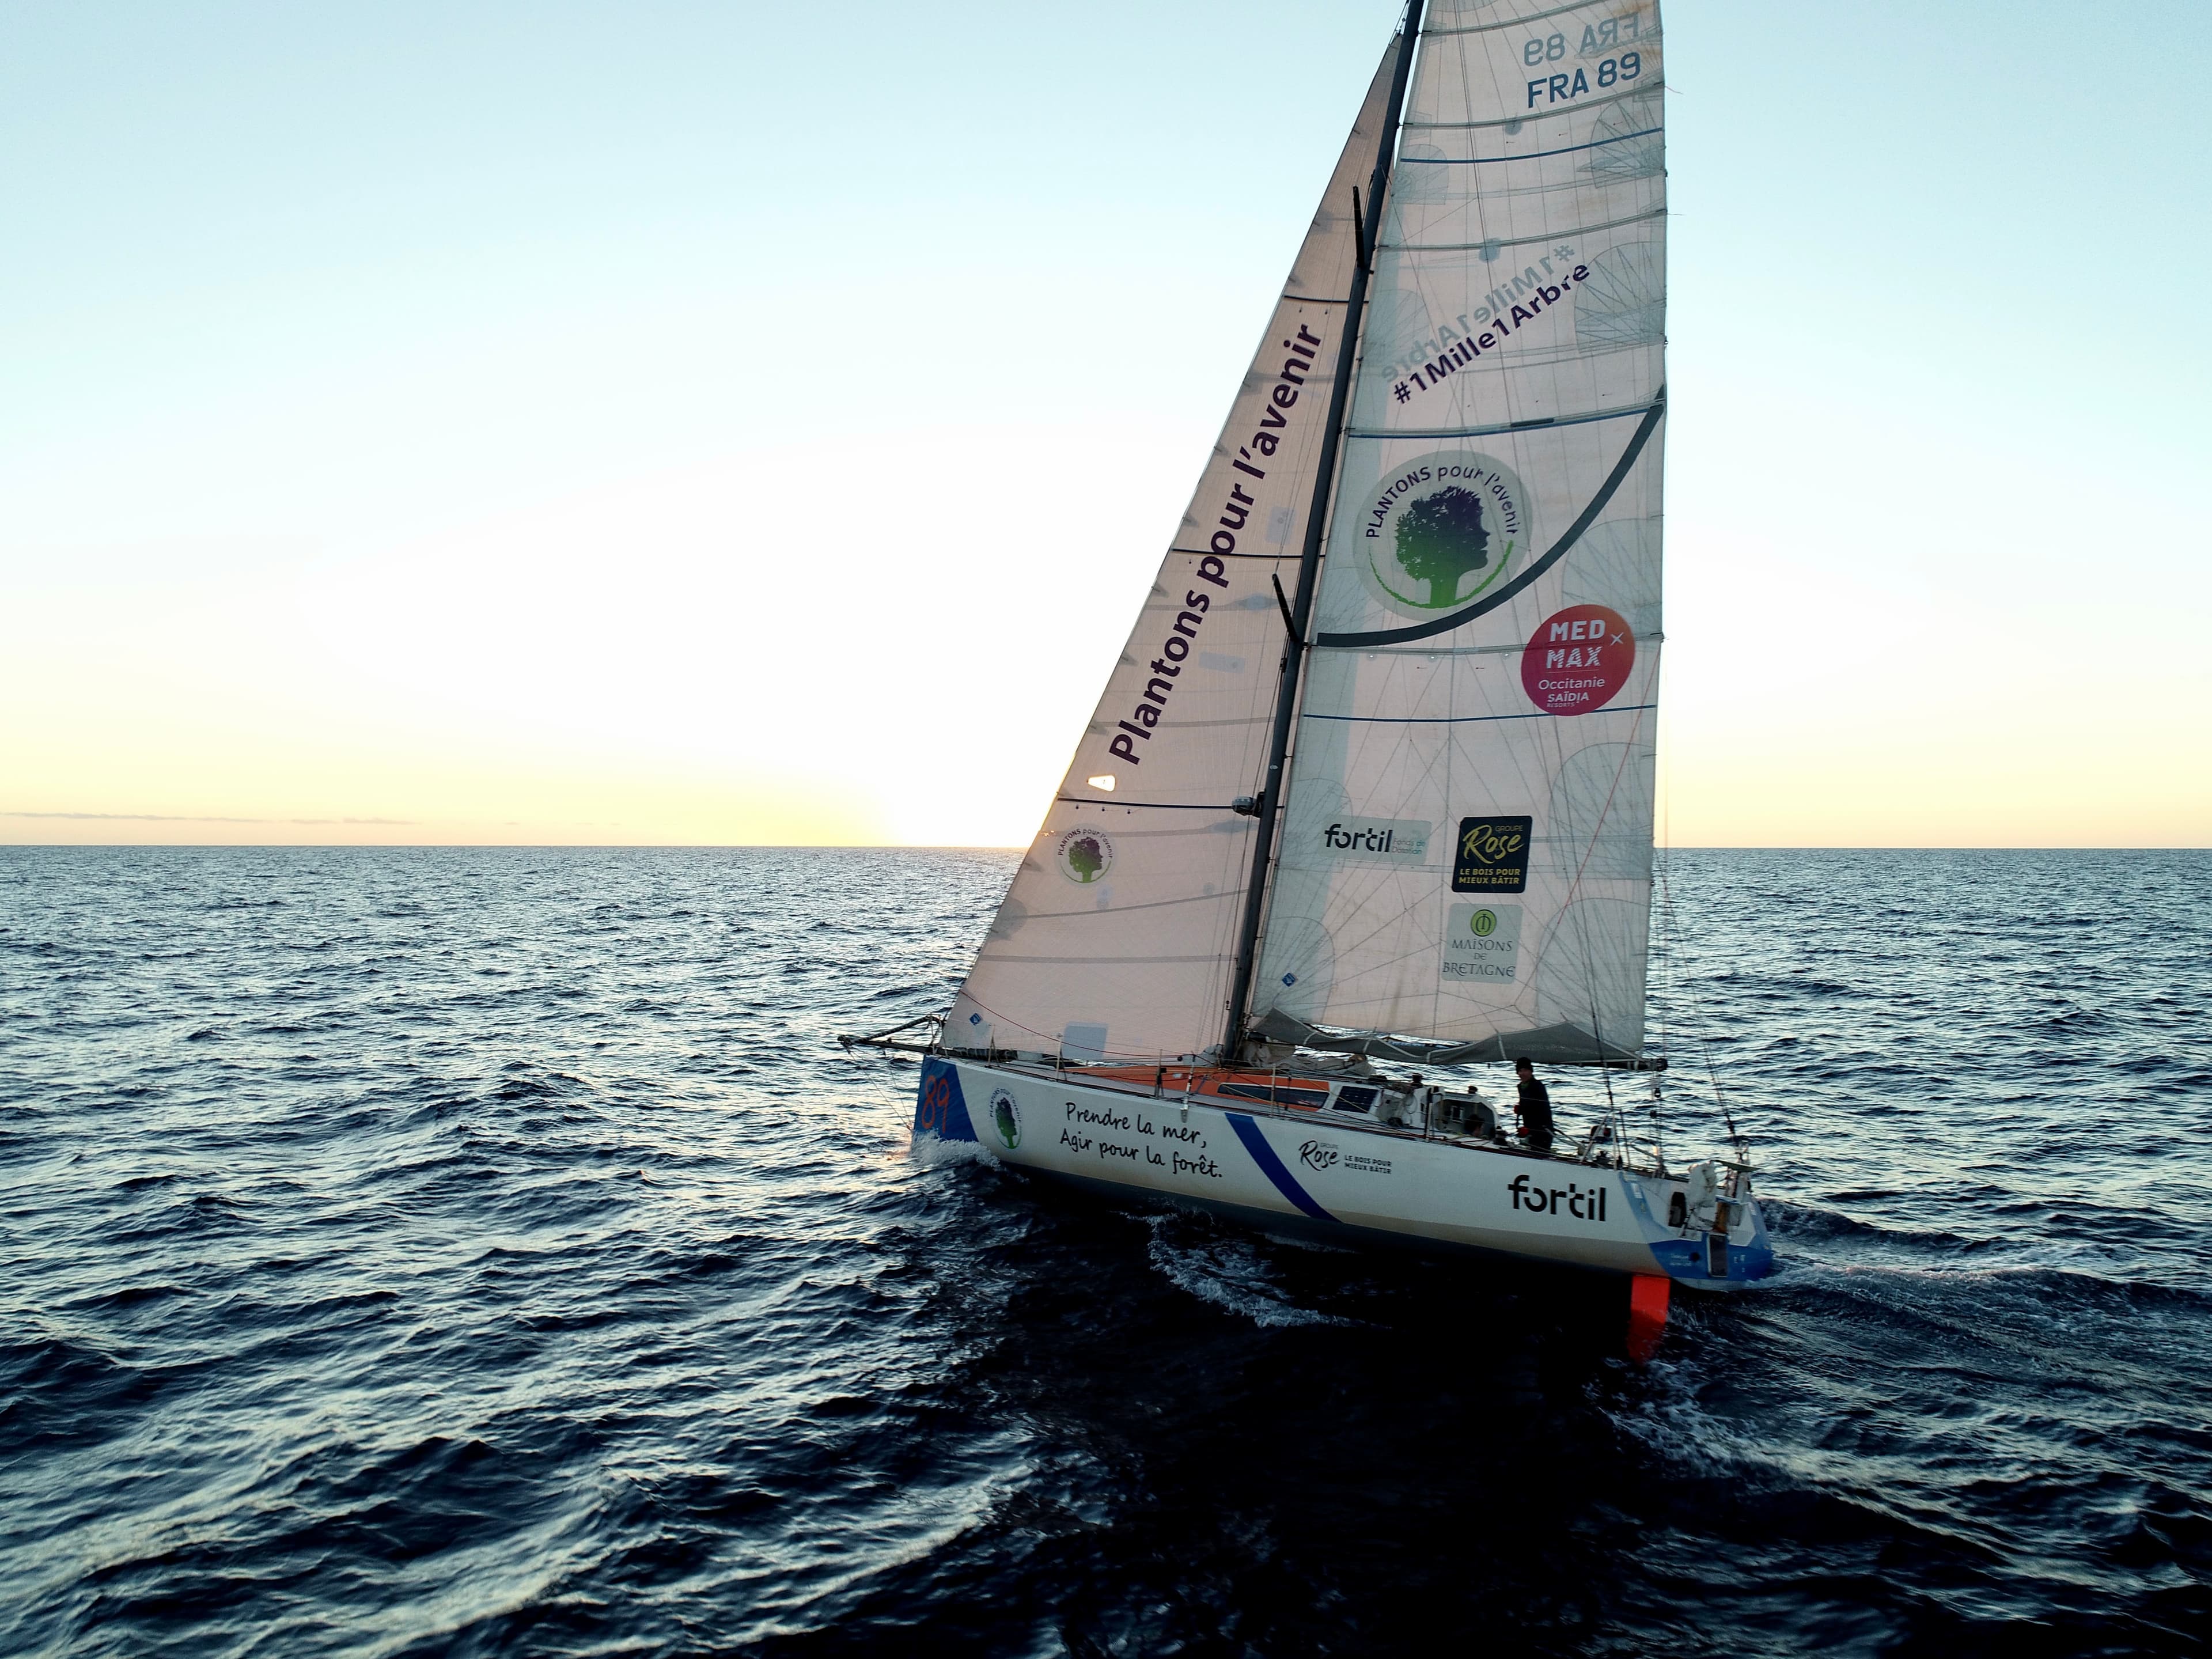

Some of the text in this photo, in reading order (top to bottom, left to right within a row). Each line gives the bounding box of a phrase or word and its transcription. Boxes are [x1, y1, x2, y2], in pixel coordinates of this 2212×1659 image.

[1527, 52, 1641, 108] FRA 89
[1393, 264, 1590, 404] #1Mille1Arbre
[1366, 465, 1521, 537] PLANTONS pour l'avenir
[1108, 323, 1321, 766] Plantons pour l'avenir
[1550, 619, 1606, 642] MED
[1546, 646, 1603, 669] MAX
[1539, 676, 1605, 690] Occitanie
[1058, 828, 1081, 856] PLANTONS
[1324, 823, 1393, 853] fortil
[1463, 824, 1525, 864] Rose
[1491, 876, 1520, 884] BÂTIR
[1442, 962, 1516, 977] BRETAGNE
[922, 1075, 950, 1134] 89
[1066, 1102, 1206, 1148] Prendre la mer,
[1060, 1128, 1222, 1177] Agir pour la forêt.
[1298, 1140, 1340, 1172] Rose
[1344, 1162, 1392, 1175] MIEUX BÂTIR
[1354, 1156, 1370, 1164] BOIS
[1372, 1158, 1392, 1167] POUR
[1508, 1174, 1607, 1222] fortil
